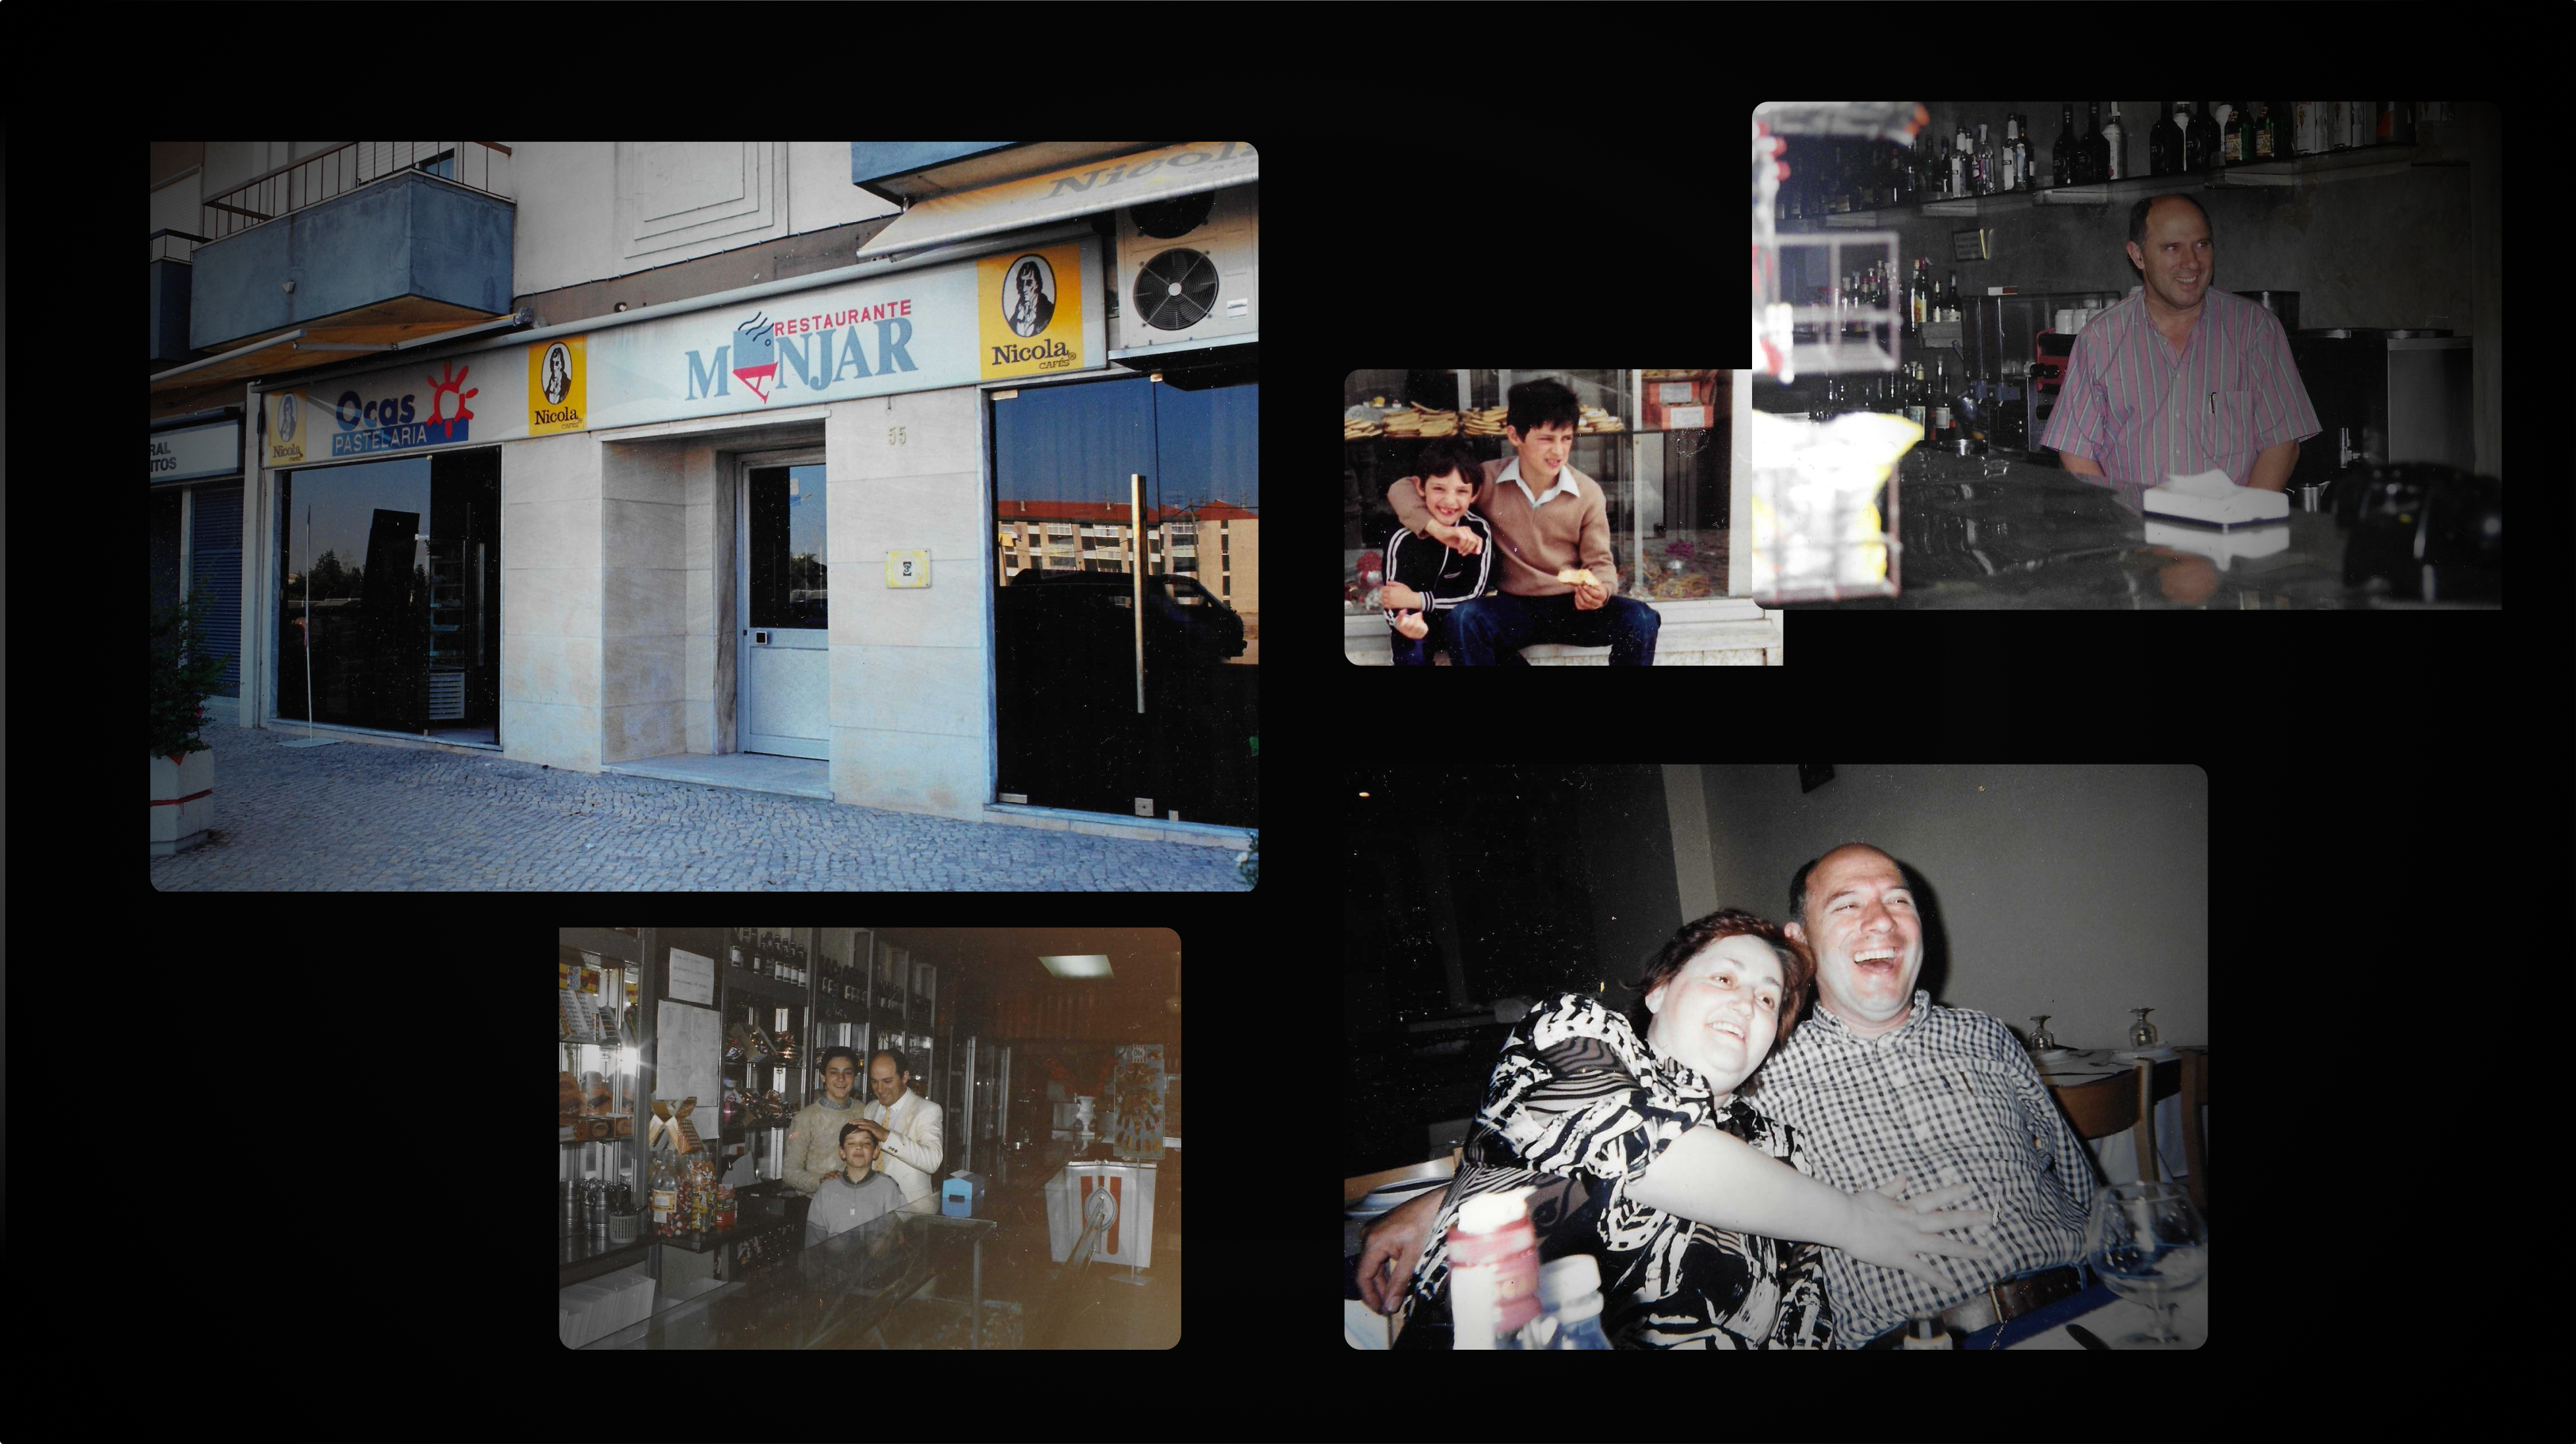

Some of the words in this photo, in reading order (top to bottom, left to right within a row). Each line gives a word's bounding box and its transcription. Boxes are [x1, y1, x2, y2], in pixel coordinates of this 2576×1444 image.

[775, 299, 912, 336] RESTAURANTE
[685, 317, 919, 404] MANJAR
[991, 339, 1069, 365] Nicola
[1039, 357, 1070, 369] CAFÉS
[336, 390, 416, 432] Ocas
[535, 407, 579, 425] Nicola
[334, 425, 427, 453] PASTELARIA
[889, 426, 906, 446] 55
[273, 443, 301, 458] Nicola
